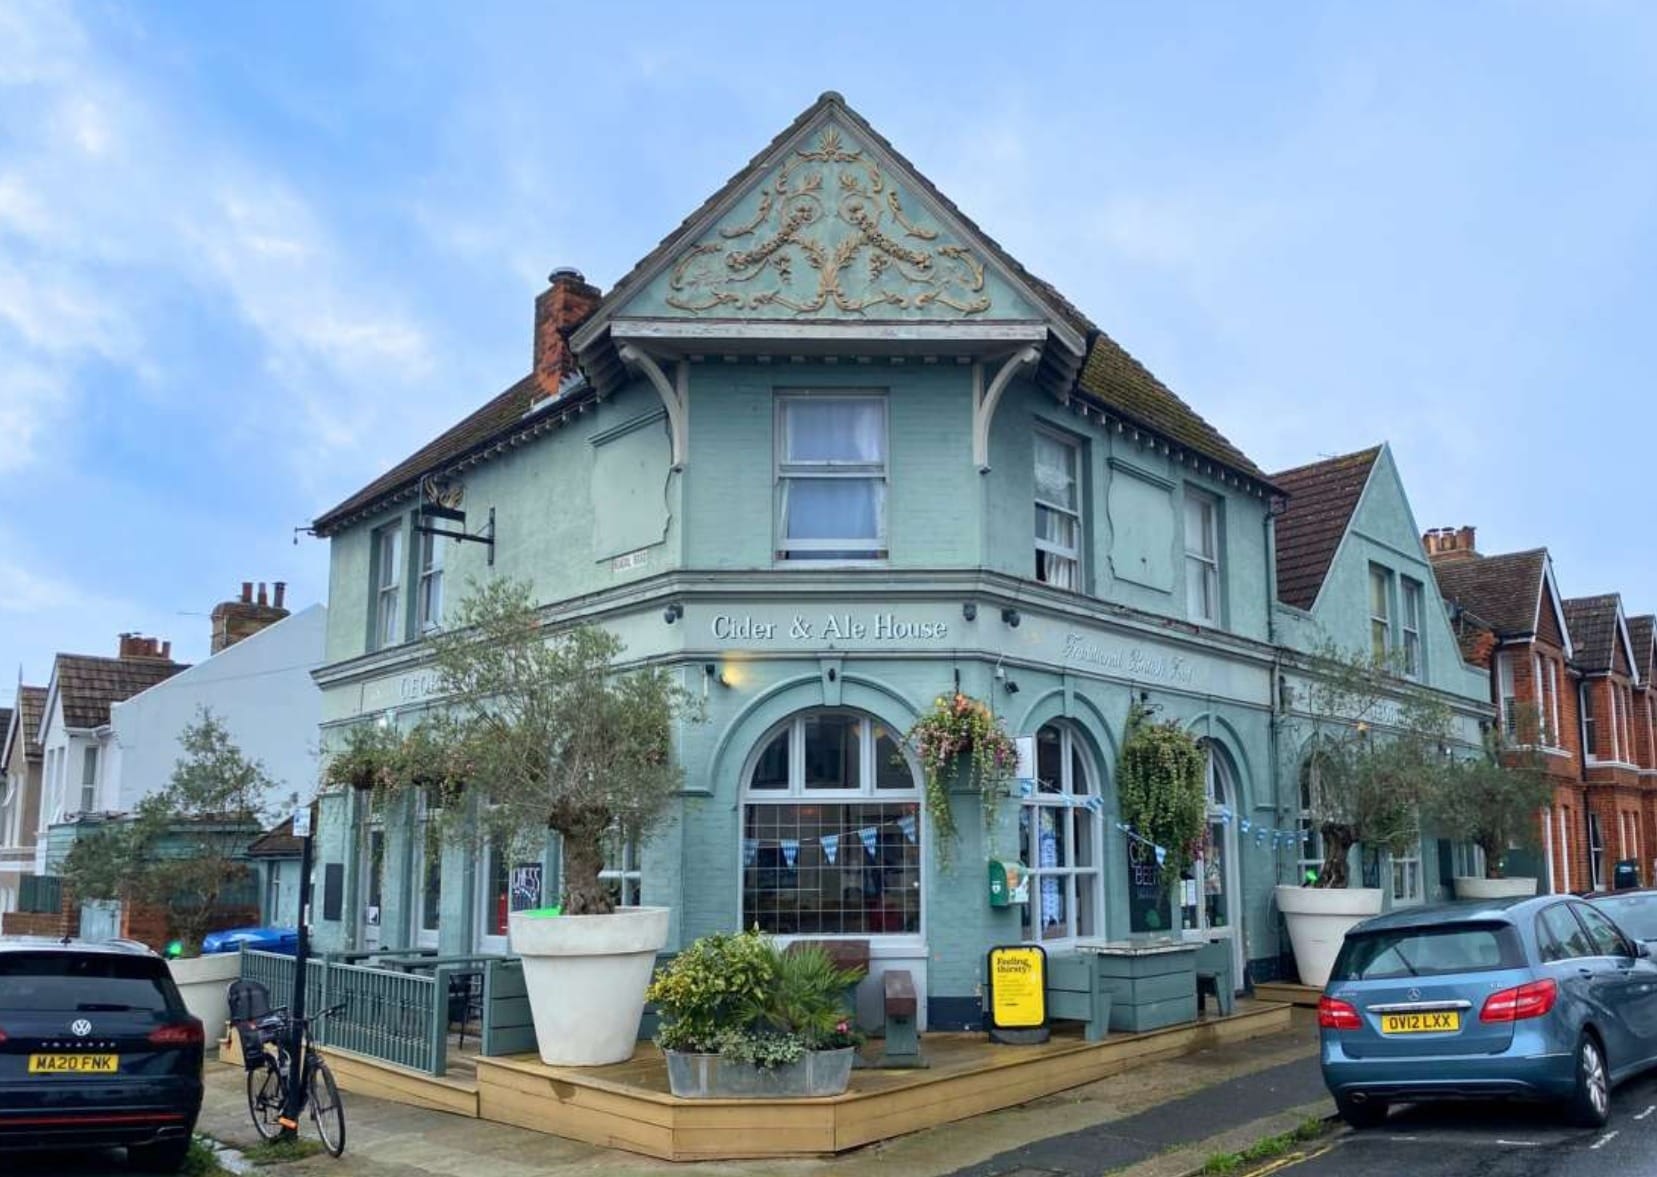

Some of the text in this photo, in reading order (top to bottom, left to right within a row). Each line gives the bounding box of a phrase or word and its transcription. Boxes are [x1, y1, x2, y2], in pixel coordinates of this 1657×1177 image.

[711, 613, 949, 640] Cider & Ale House
[1422, 1015, 1451, 1028] LXX
[36, 1056, 111, 1070] MA20 FNK
